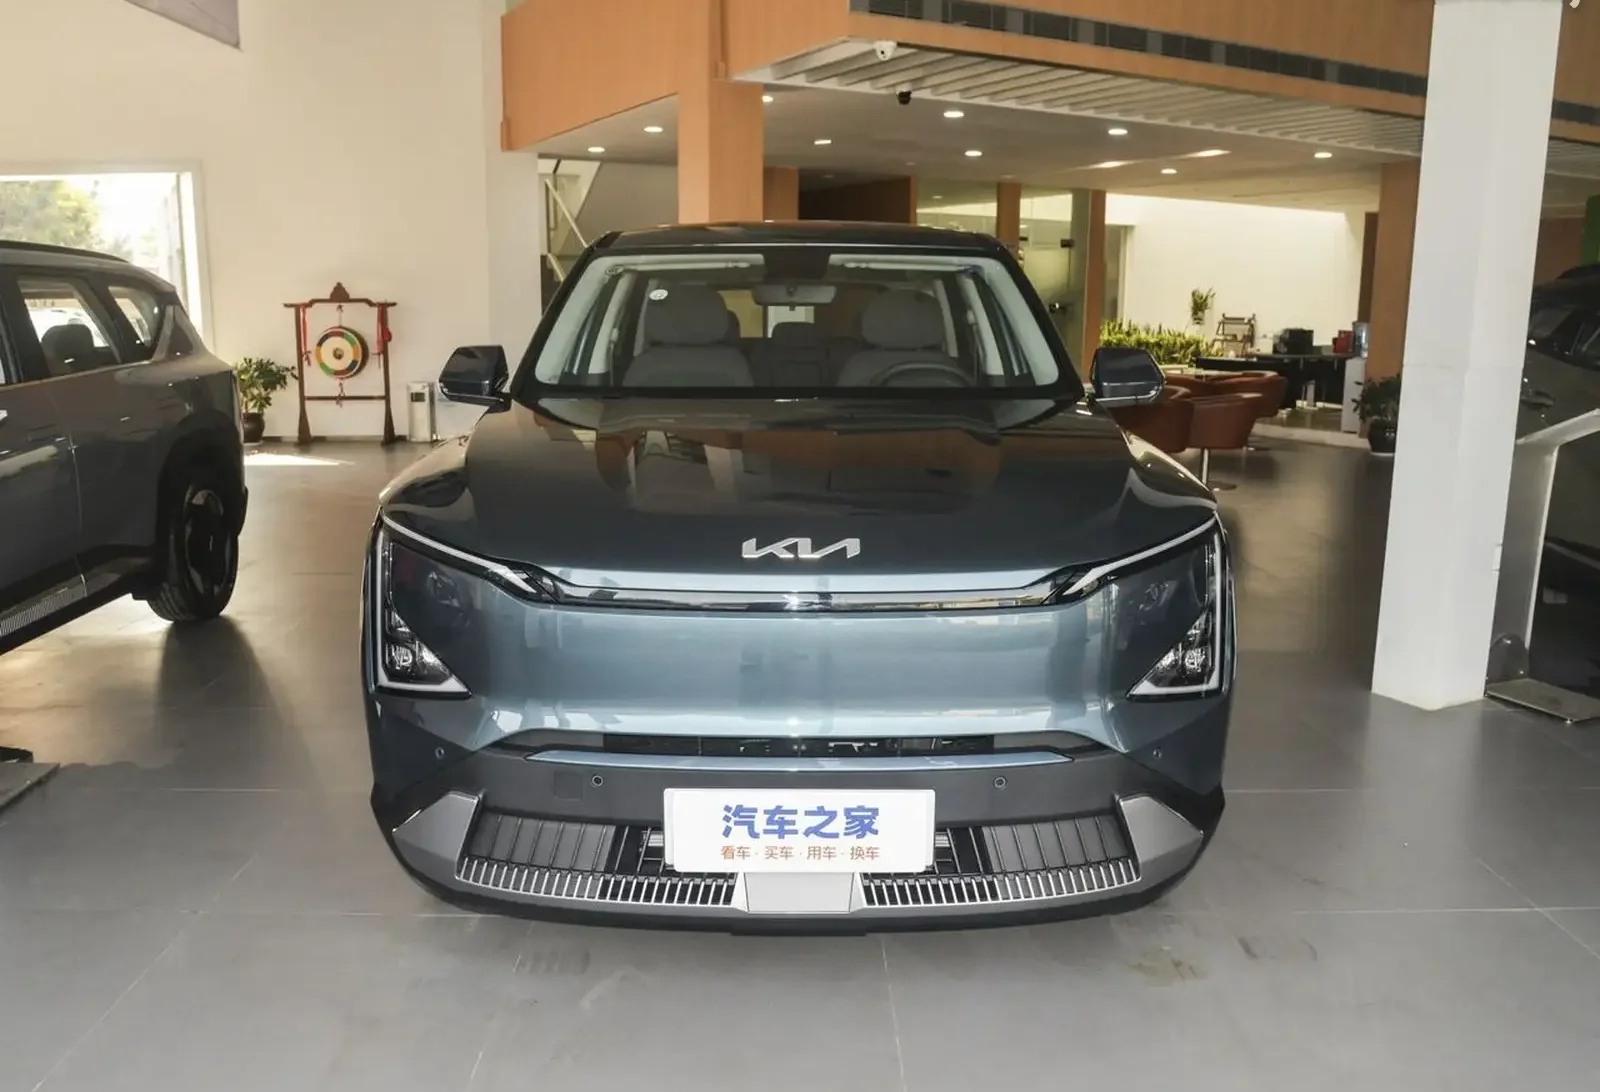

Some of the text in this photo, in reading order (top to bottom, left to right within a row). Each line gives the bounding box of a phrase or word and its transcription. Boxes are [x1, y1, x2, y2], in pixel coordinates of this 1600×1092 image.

[742, 537, 860, 558] KIA
[722, 804, 879, 839] 汽车之家
